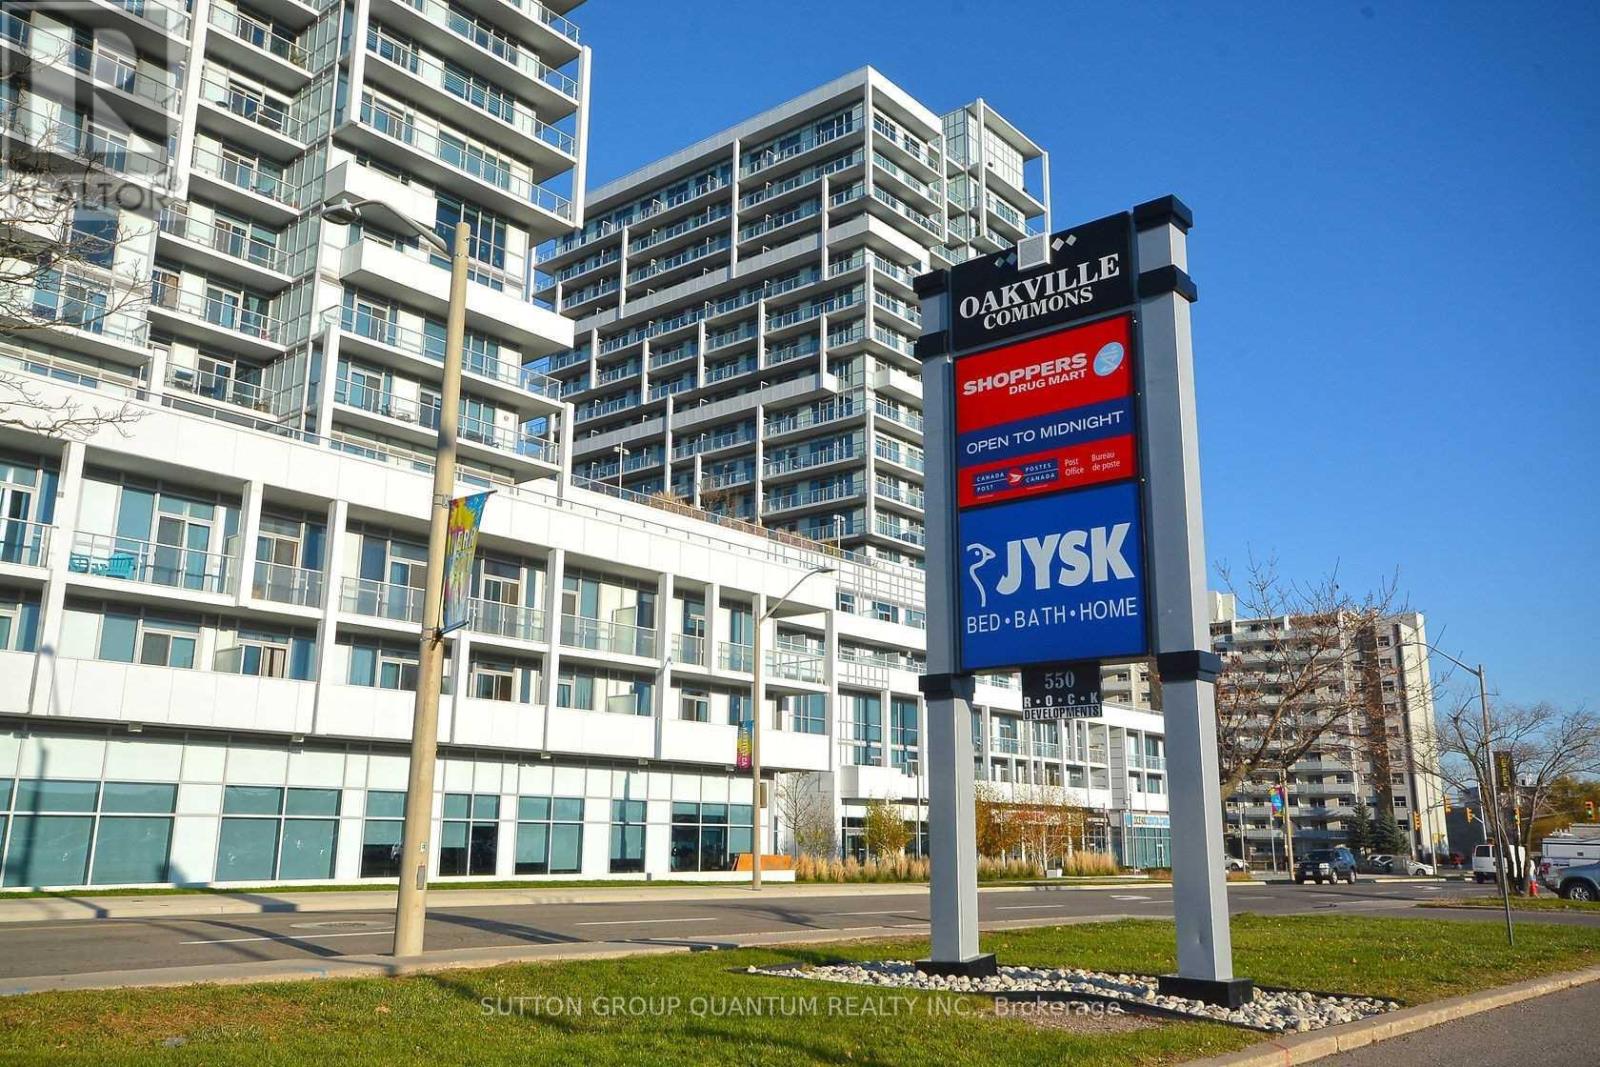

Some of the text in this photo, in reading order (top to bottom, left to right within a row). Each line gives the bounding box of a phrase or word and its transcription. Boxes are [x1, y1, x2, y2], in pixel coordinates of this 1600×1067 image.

[959, 253, 1120, 319] OAKVILLE
[983, 286, 1094, 330] COMMONS
[962, 352, 1088, 396] SHOPPERS
[1009, 368, 1087, 395] DRUG MART
[966, 410, 1124, 455] OPEN TO MIDNIGHT
[1064, 458, 1079, 467] Post
[1091, 451, 1116, 462] Bureau
[1025, 462, 1052, 472] POSTES
[1065, 466, 1085, 477] Office
[1092, 460, 1121, 473] de poste
[976, 471, 1005, 482] CANADA
[1025, 473, 1055, 484] CANADA
[976, 484, 994, 493] POST
[996, 522, 1136, 595] JYSK
[1044, 671, 1076, 690] 550
[1024, 705, 1100, 720] DEVELOPMENTS
